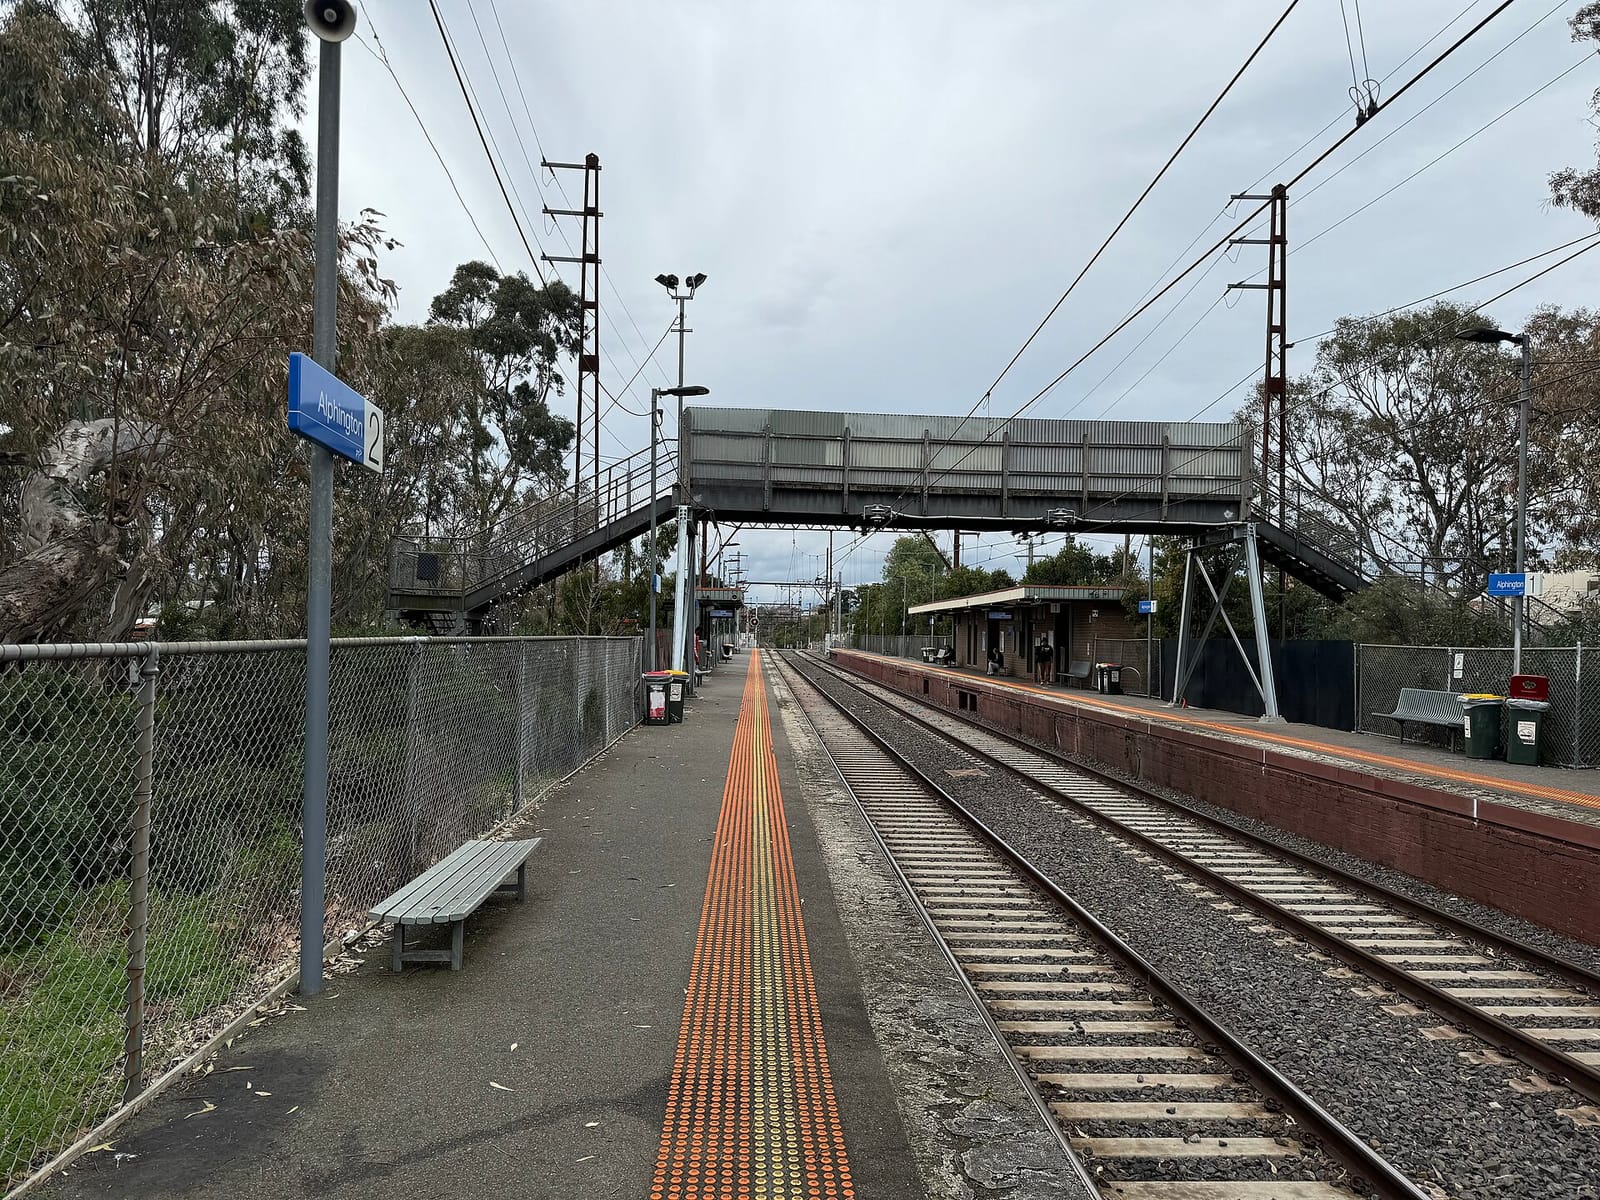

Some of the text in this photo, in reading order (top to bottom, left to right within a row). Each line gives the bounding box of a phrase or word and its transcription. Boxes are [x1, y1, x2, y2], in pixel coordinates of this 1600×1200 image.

[317, 391, 363, 438] Alphington
[368, 411, 380, 466] 2
[1496, 580, 1524, 590] Alphington
[1529, 575, 1535, 594] 1
